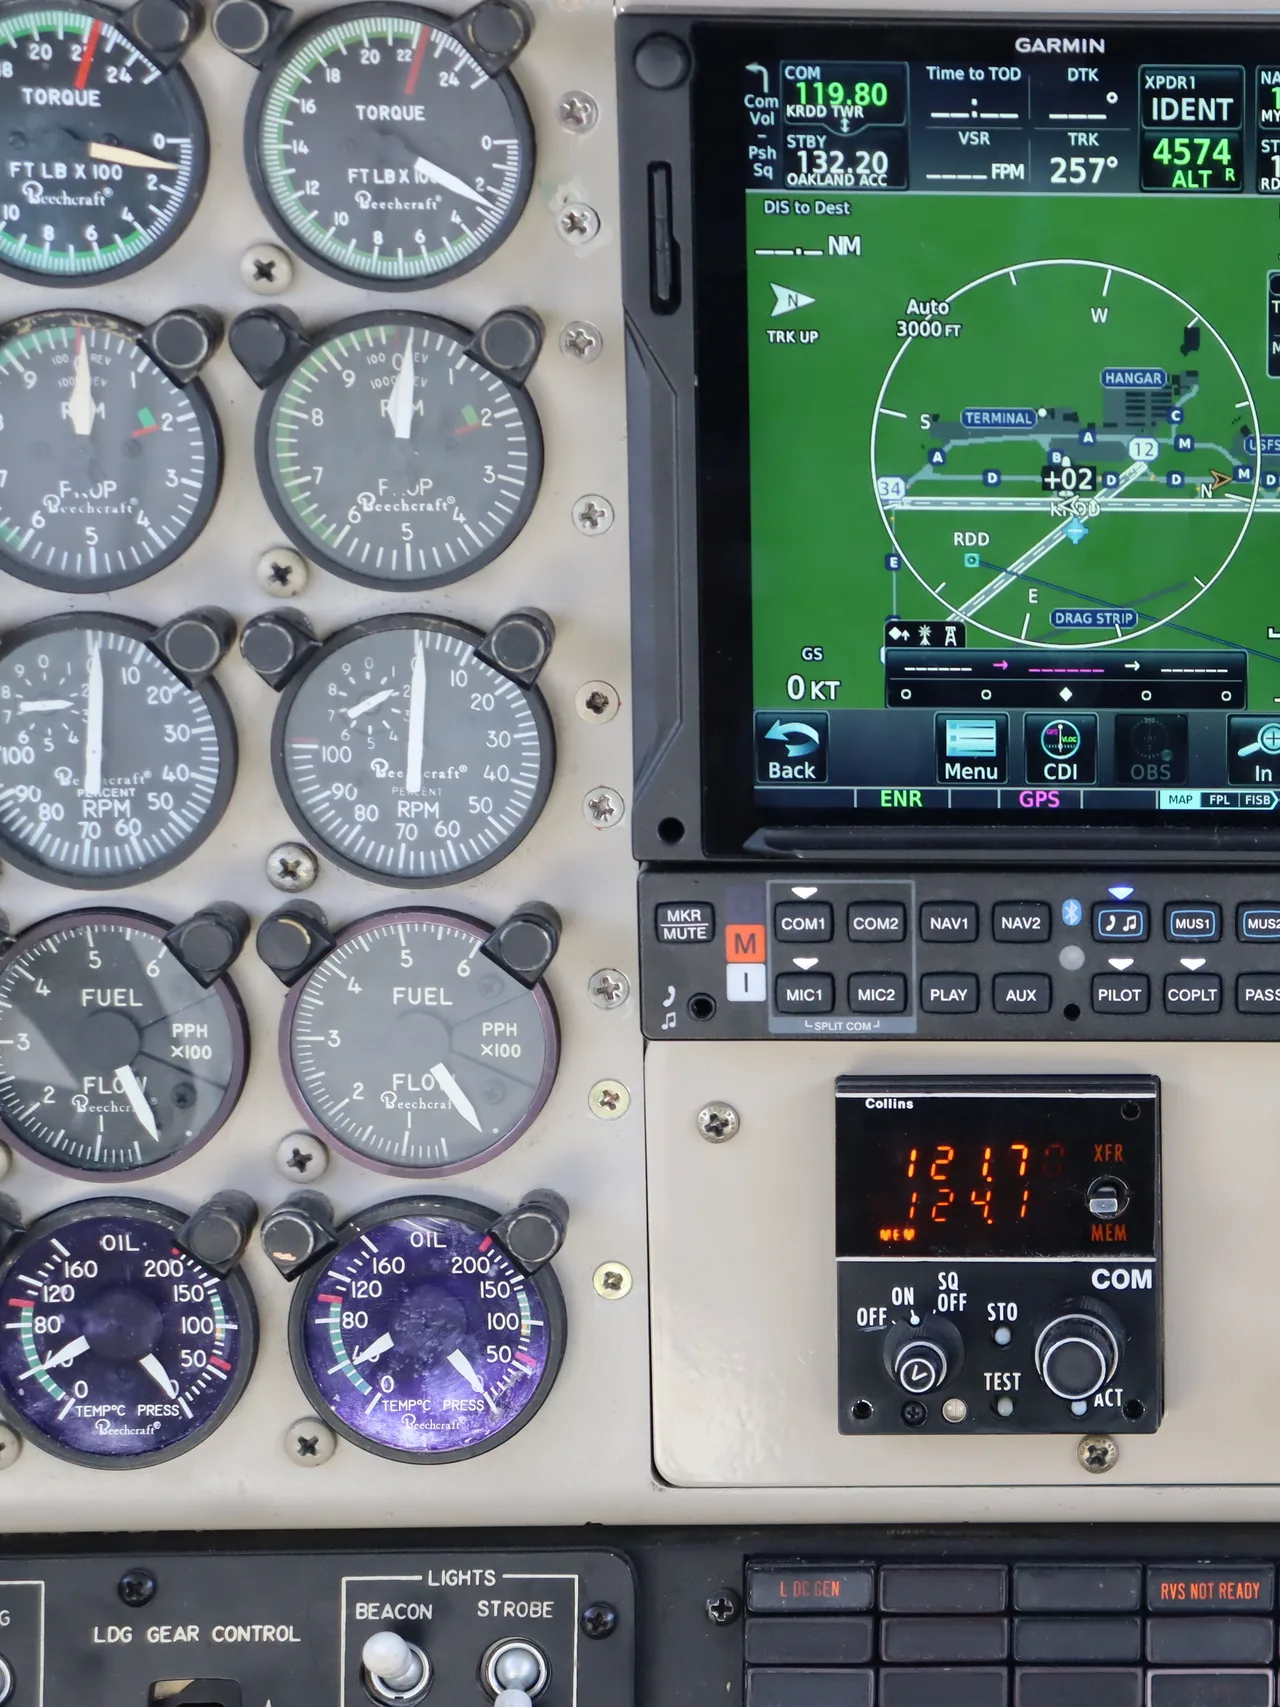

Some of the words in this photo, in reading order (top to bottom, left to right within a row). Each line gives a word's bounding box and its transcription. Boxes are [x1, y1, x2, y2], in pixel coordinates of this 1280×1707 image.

[1015, 37, 1106, 54] GARMIN
[360, 49, 380, 64] 20
[784, 65, 821, 81] COM
[926, 65, 965, 81] Time
[969, 67, 985, 81] to
[988, 66, 1022, 82] TOD
[1067, 67, 1099, 82] DTK
[1144, 75, 1196, 90] XPDR1
[22, 88, 100, 107] TORQUE
[796, 81, 888, 107] 119.80
[300, 100, 317, 115] 16
[355, 104, 425, 122] TORQUE
[786, 104, 827, 119] KRDD
[830, 104, 864, 120] TWR
[1152, 97, 1234, 121] IDENT
[786, 134, 827, 149] STBY
[958, 131, 991, 146] VSR
[1068, 132, 1100, 147] TRK
[1152, 137, 1232, 165] 4574
[797, 150, 889, 175] 132.20
[786, 172, 854, 187] OAKLAND
[859, 173, 888, 187] ACC
[1171, 169, 1213, 188] ALT
[764, 200, 790, 215] DIS
[794, 201, 810, 215] to
[815, 201, 850, 216] Dest
[828, 235, 861, 256] NM
[906, 298, 950, 315] Auto
[766, 330, 796, 343] TRK
[799, 330, 819, 343] UP
[896, 320, 942, 337] 3000
[945, 324, 961, 337] FT
[1105, 372, 1162, 385] HANGAR
[965, 412, 1032, 424] TERMINAL
[953, 532, 990, 546] RDD
[1055, 613, 1092, 624] DRAG
[1096, 612, 1133, 625] STRIP
[147, 687, 173, 704] 20
[164, 725, 191, 743] 30
[486, 730, 511, 747] 30
[320, 745, 353, 764] 100
[483, 764, 510, 781] 40
[768, 762, 815, 779] Back
[945, 763, 998, 780] Menu
[1043, 763, 1078, 780] CDI
[880, 790, 922, 807] ENR
[1019, 789, 1060, 808] GPS
[39, 803, 64, 822] 80
[83, 799, 131, 819] RPM
[397, 799, 440, 819] RPM
[667, 910, 701, 922] MKR
[781, 917, 825, 931] COM1
[930, 917, 968, 930] NAV1
[1001, 917, 1041, 930] NAV2
[1175, 918, 1211, 930] MUS1
[663, 926, 707, 940] MUTE
[81, 988, 143, 1007] FUEL
[393, 987, 453, 1006] FUEL
[786, 988, 822, 1001] MIC1
[930, 988, 967, 1001] PLAY
[1005, 989, 1037, 1002] AUX
[1098, 988, 1141, 1002] PILOT
[1168, 988, 1217, 1002] COPLT
[171, 1023, 209, 1039] PPH
[814, 1021, 843, 1032] SPLIT
[845, 1021, 872, 1032] COM
[865, 1098, 914, 1109] Collins
[1094, 1144, 1124, 1162] XFR
[410, 1231, 447, 1250] OIL
[1091, 1224, 1127, 1241] MEM
[101, 1233, 140, 1253] OIL
[65, 1260, 98, 1278] 160
[451, 1256, 491, 1274] 200
[1091, 1269, 1152, 1289] COM
[173, 1284, 205, 1303] 150
[351, 1281, 383, 1299] 120
[987, 1303, 1018, 1321] STO
[984, 1373, 1021, 1391] TEST
[137, 1404, 180, 1418] PRESS
[428, 1568, 497, 1588] LIGHTS
[1161, 1582, 1186, 1600] RVS
[1190, 1582, 1215, 1600] NOT
[1219, 1582, 1261, 1599] READY
[355, 1602, 433, 1620] BEACON
[477, 1600, 555, 1619] STROBE
[94, 1625, 133, 1644] LDG
[146, 1624, 200, 1643] GEAR
[212, 1624, 301, 1644] CONTROL
